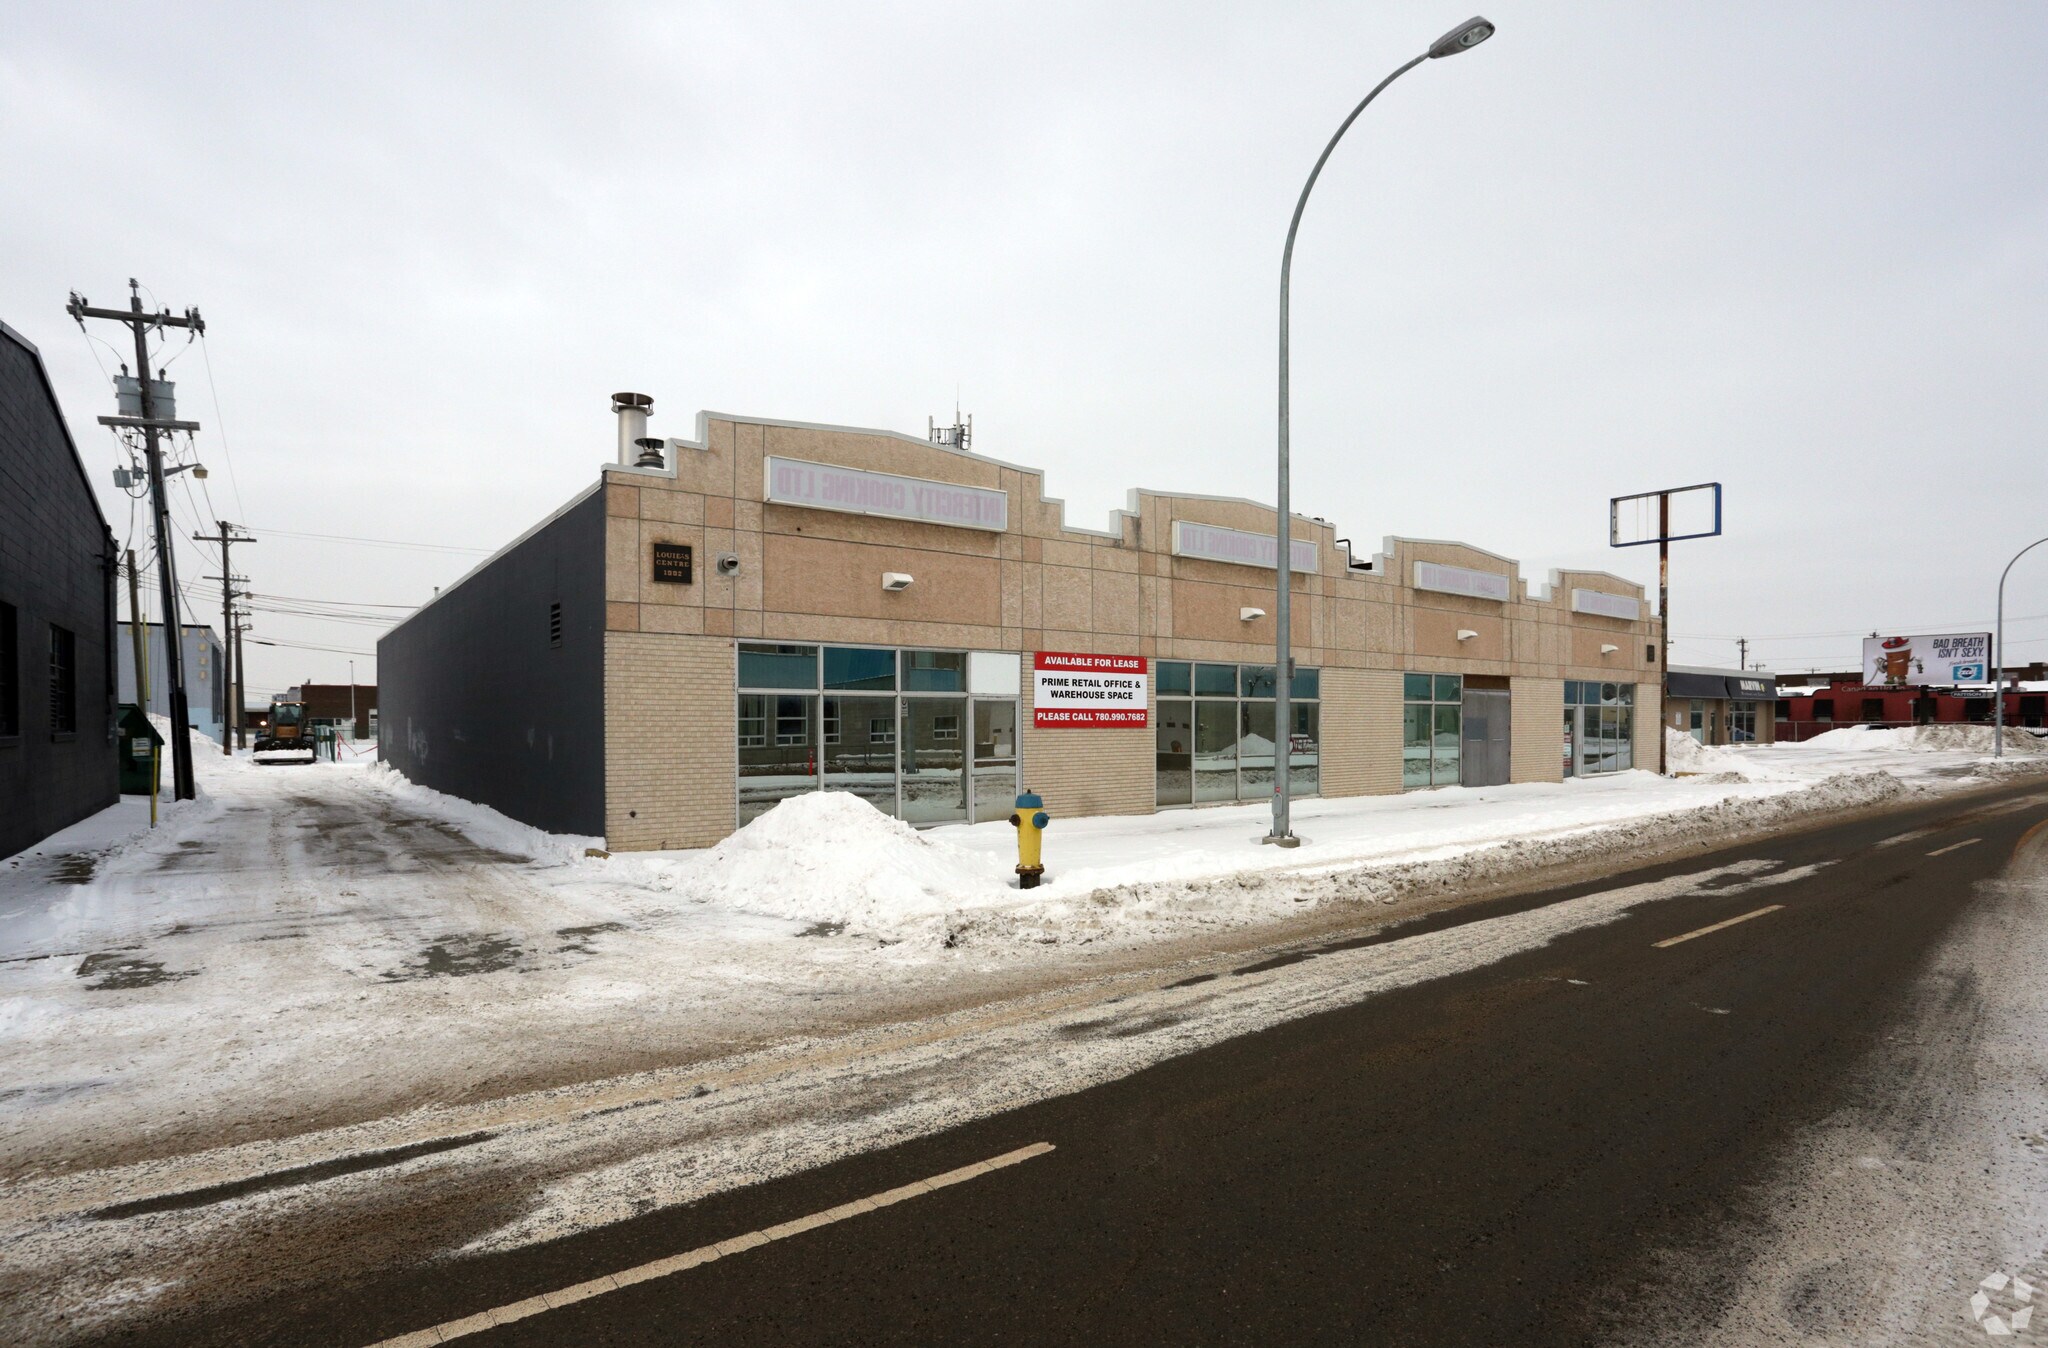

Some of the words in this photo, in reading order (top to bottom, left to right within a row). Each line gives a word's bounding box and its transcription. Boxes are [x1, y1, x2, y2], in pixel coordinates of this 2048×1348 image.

[656, 559, 690, 568] CENTRE
[1933, 638, 1952, 649] BAD
[1952, 637, 1984, 648] BREATH
[1938, 647, 1959, 658] ISN'T
[1961, 647, 1984, 657] SEXY.
[1044, 656, 1092, 667] AVAILABLE
[1094, 658, 1112, 667] FOR
[1113, 659, 1139, 668] LEASE
[1041, 677, 1069, 686] PRIME
[1071, 678, 1101, 688] RETAIL
[1104, 680, 1133, 688] OFFICE
[1135, 681, 1141, 689] &
[1050, 690, 1105, 699] WAREHOUSE
[1107, 691, 1133, 700] SPACE
[1037, 712, 1070, 721] PLEASE
[1072, 712, 1093, 721] CALL
[1095, 713, 1146, 721] 780.990.7682
